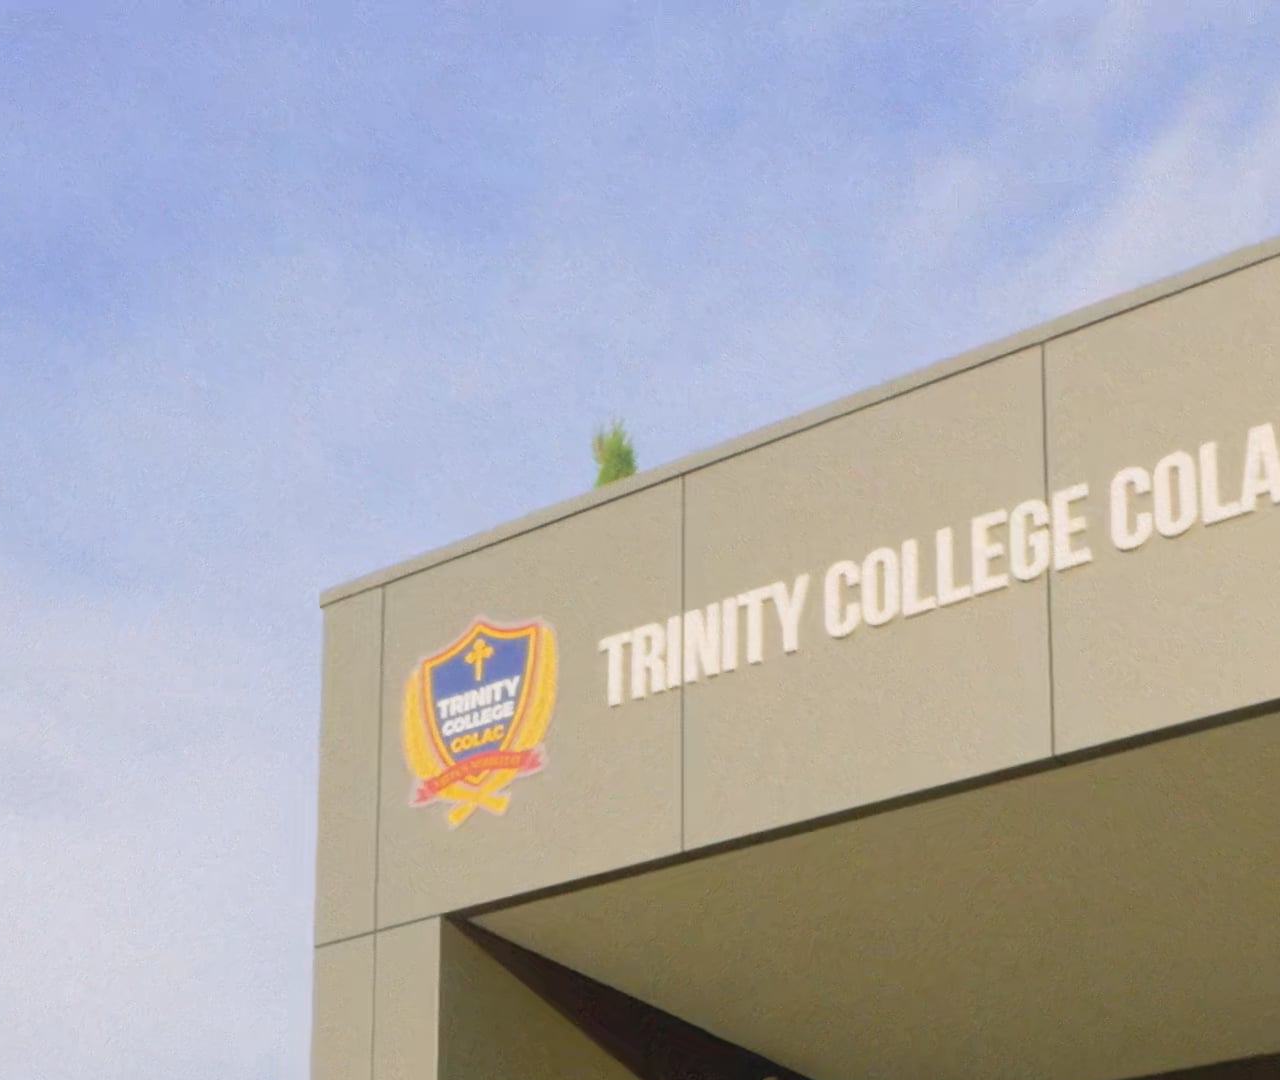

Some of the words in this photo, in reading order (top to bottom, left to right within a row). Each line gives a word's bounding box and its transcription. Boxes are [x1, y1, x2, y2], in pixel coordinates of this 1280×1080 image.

[598, 573, 810, 707] TRINITY
[823, 483, 1093, 639] COLLEGE
[438, 676, 520, 719] TRINITY
[442, 702, 515, 736] COLLEGE
[452, 726, 504, 751] COLAC
